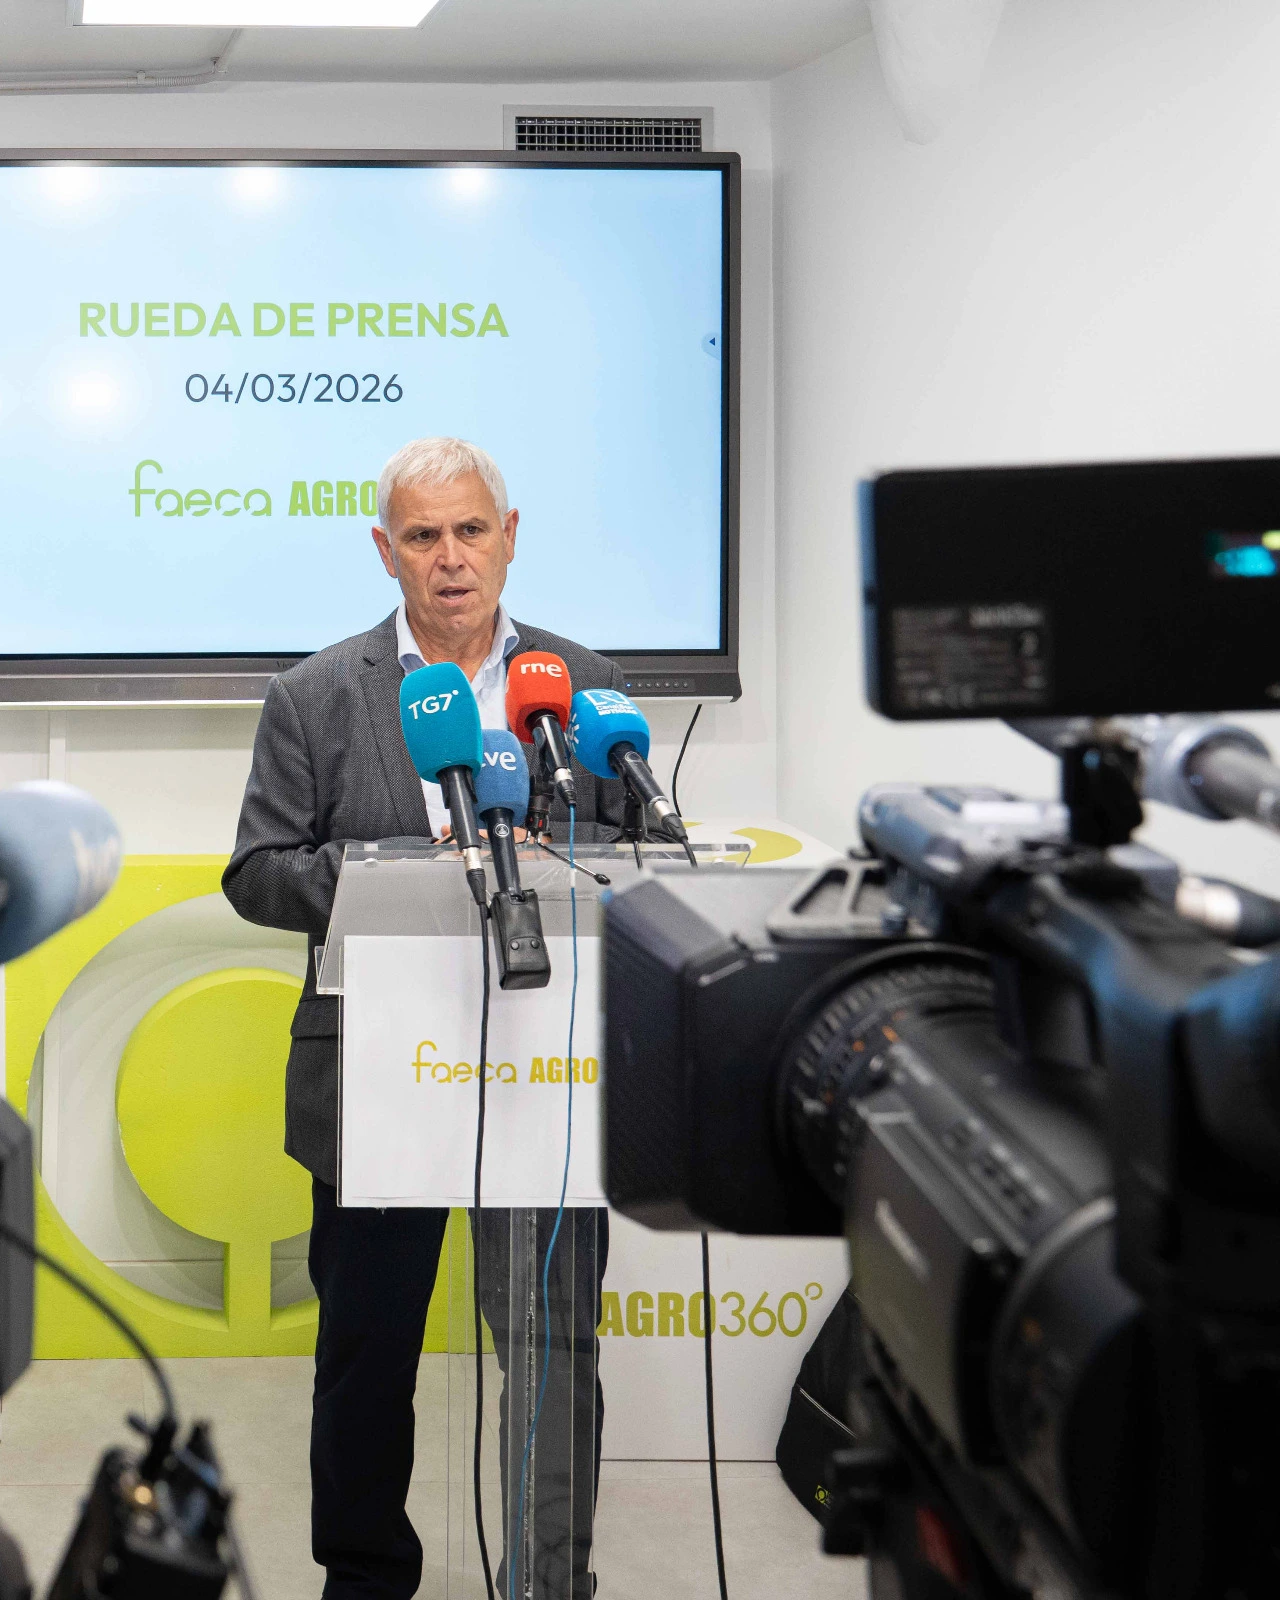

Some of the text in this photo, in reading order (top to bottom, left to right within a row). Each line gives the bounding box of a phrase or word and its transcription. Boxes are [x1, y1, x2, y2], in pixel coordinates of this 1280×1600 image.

[78, 301, 510, 338] RUEDA DE PRENSA
[184, 371, 404, 404] 04/03/2026
[128, 459, 378, 517] faeca AGRO
[520, 662, 563, 678] rne
[408, 690, 459, 720] TG7
[482, 751, 517, 771] ve
[411, 1040, 599, 1085] faeca AGRO
